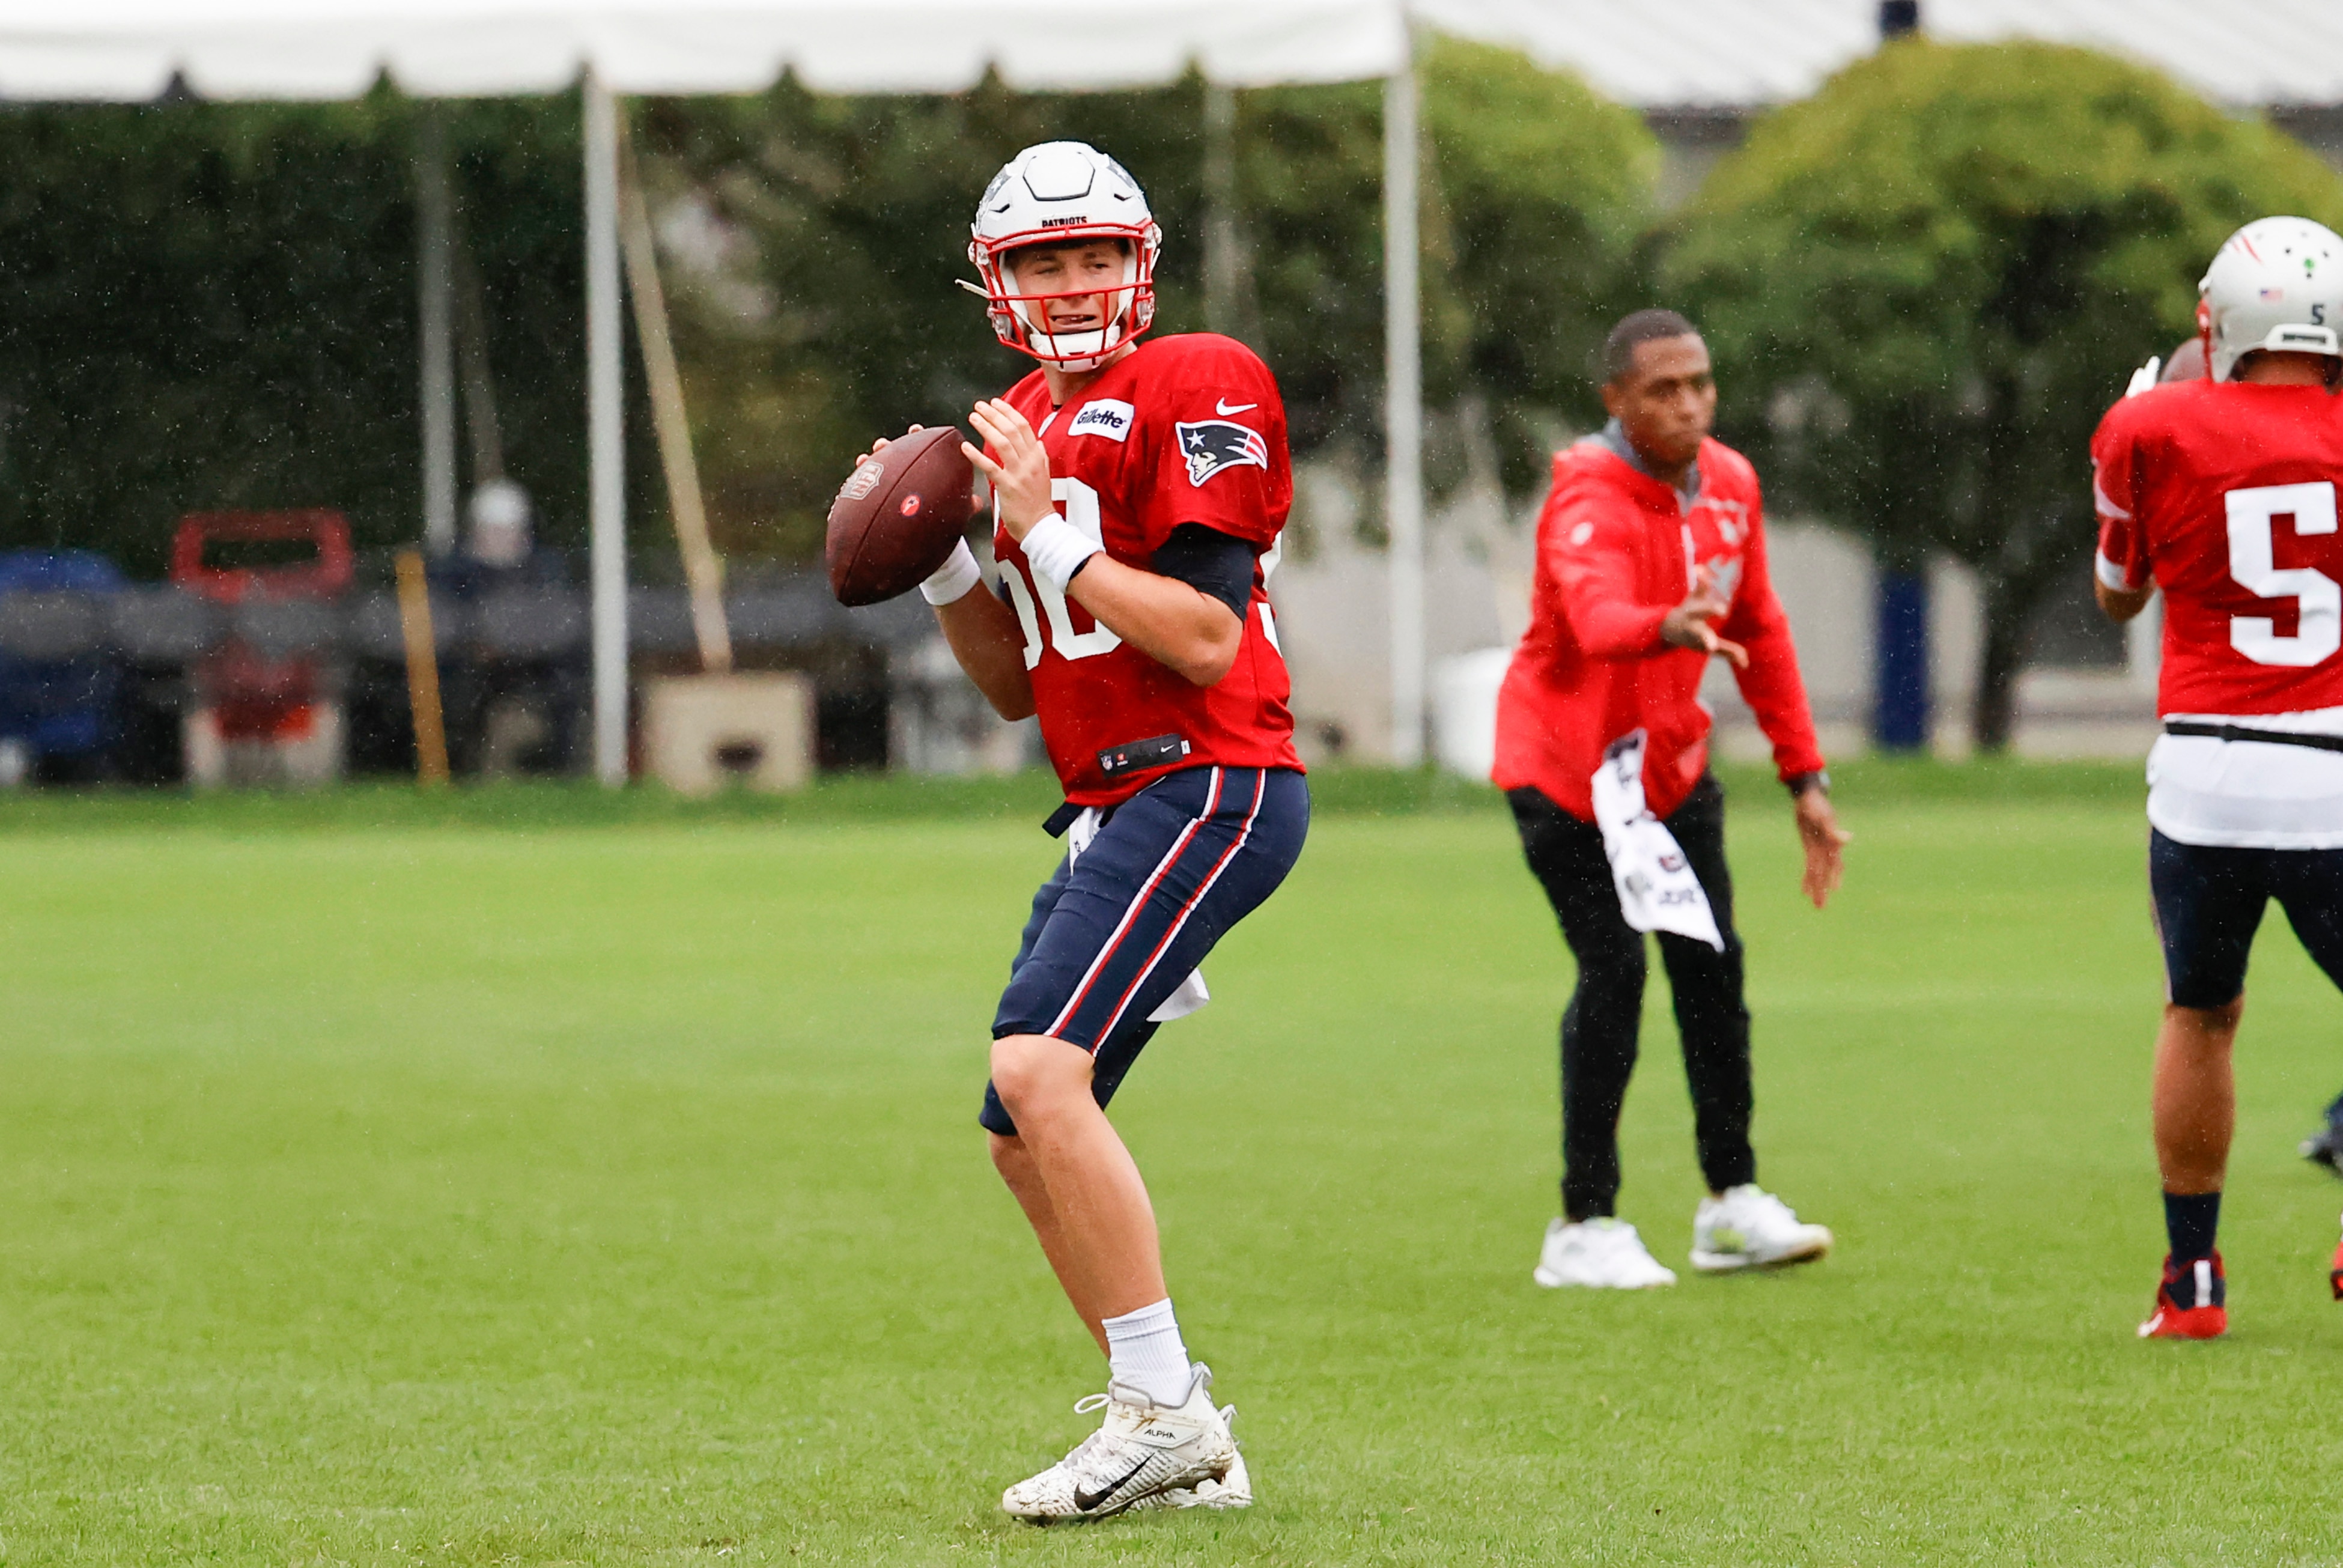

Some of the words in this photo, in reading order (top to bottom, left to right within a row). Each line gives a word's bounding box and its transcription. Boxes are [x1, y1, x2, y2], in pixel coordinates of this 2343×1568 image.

[1042, 216, 1087, 228] PATRIOTS
[2311, 303, 2324, 325] 5
[1077, 408, 1123, 428] Gillette
[851, 467, 880, 494] NFL
[2225, 481, 2341, 667] 5
[1144, 1429, 1176, 1440] ALPHA
